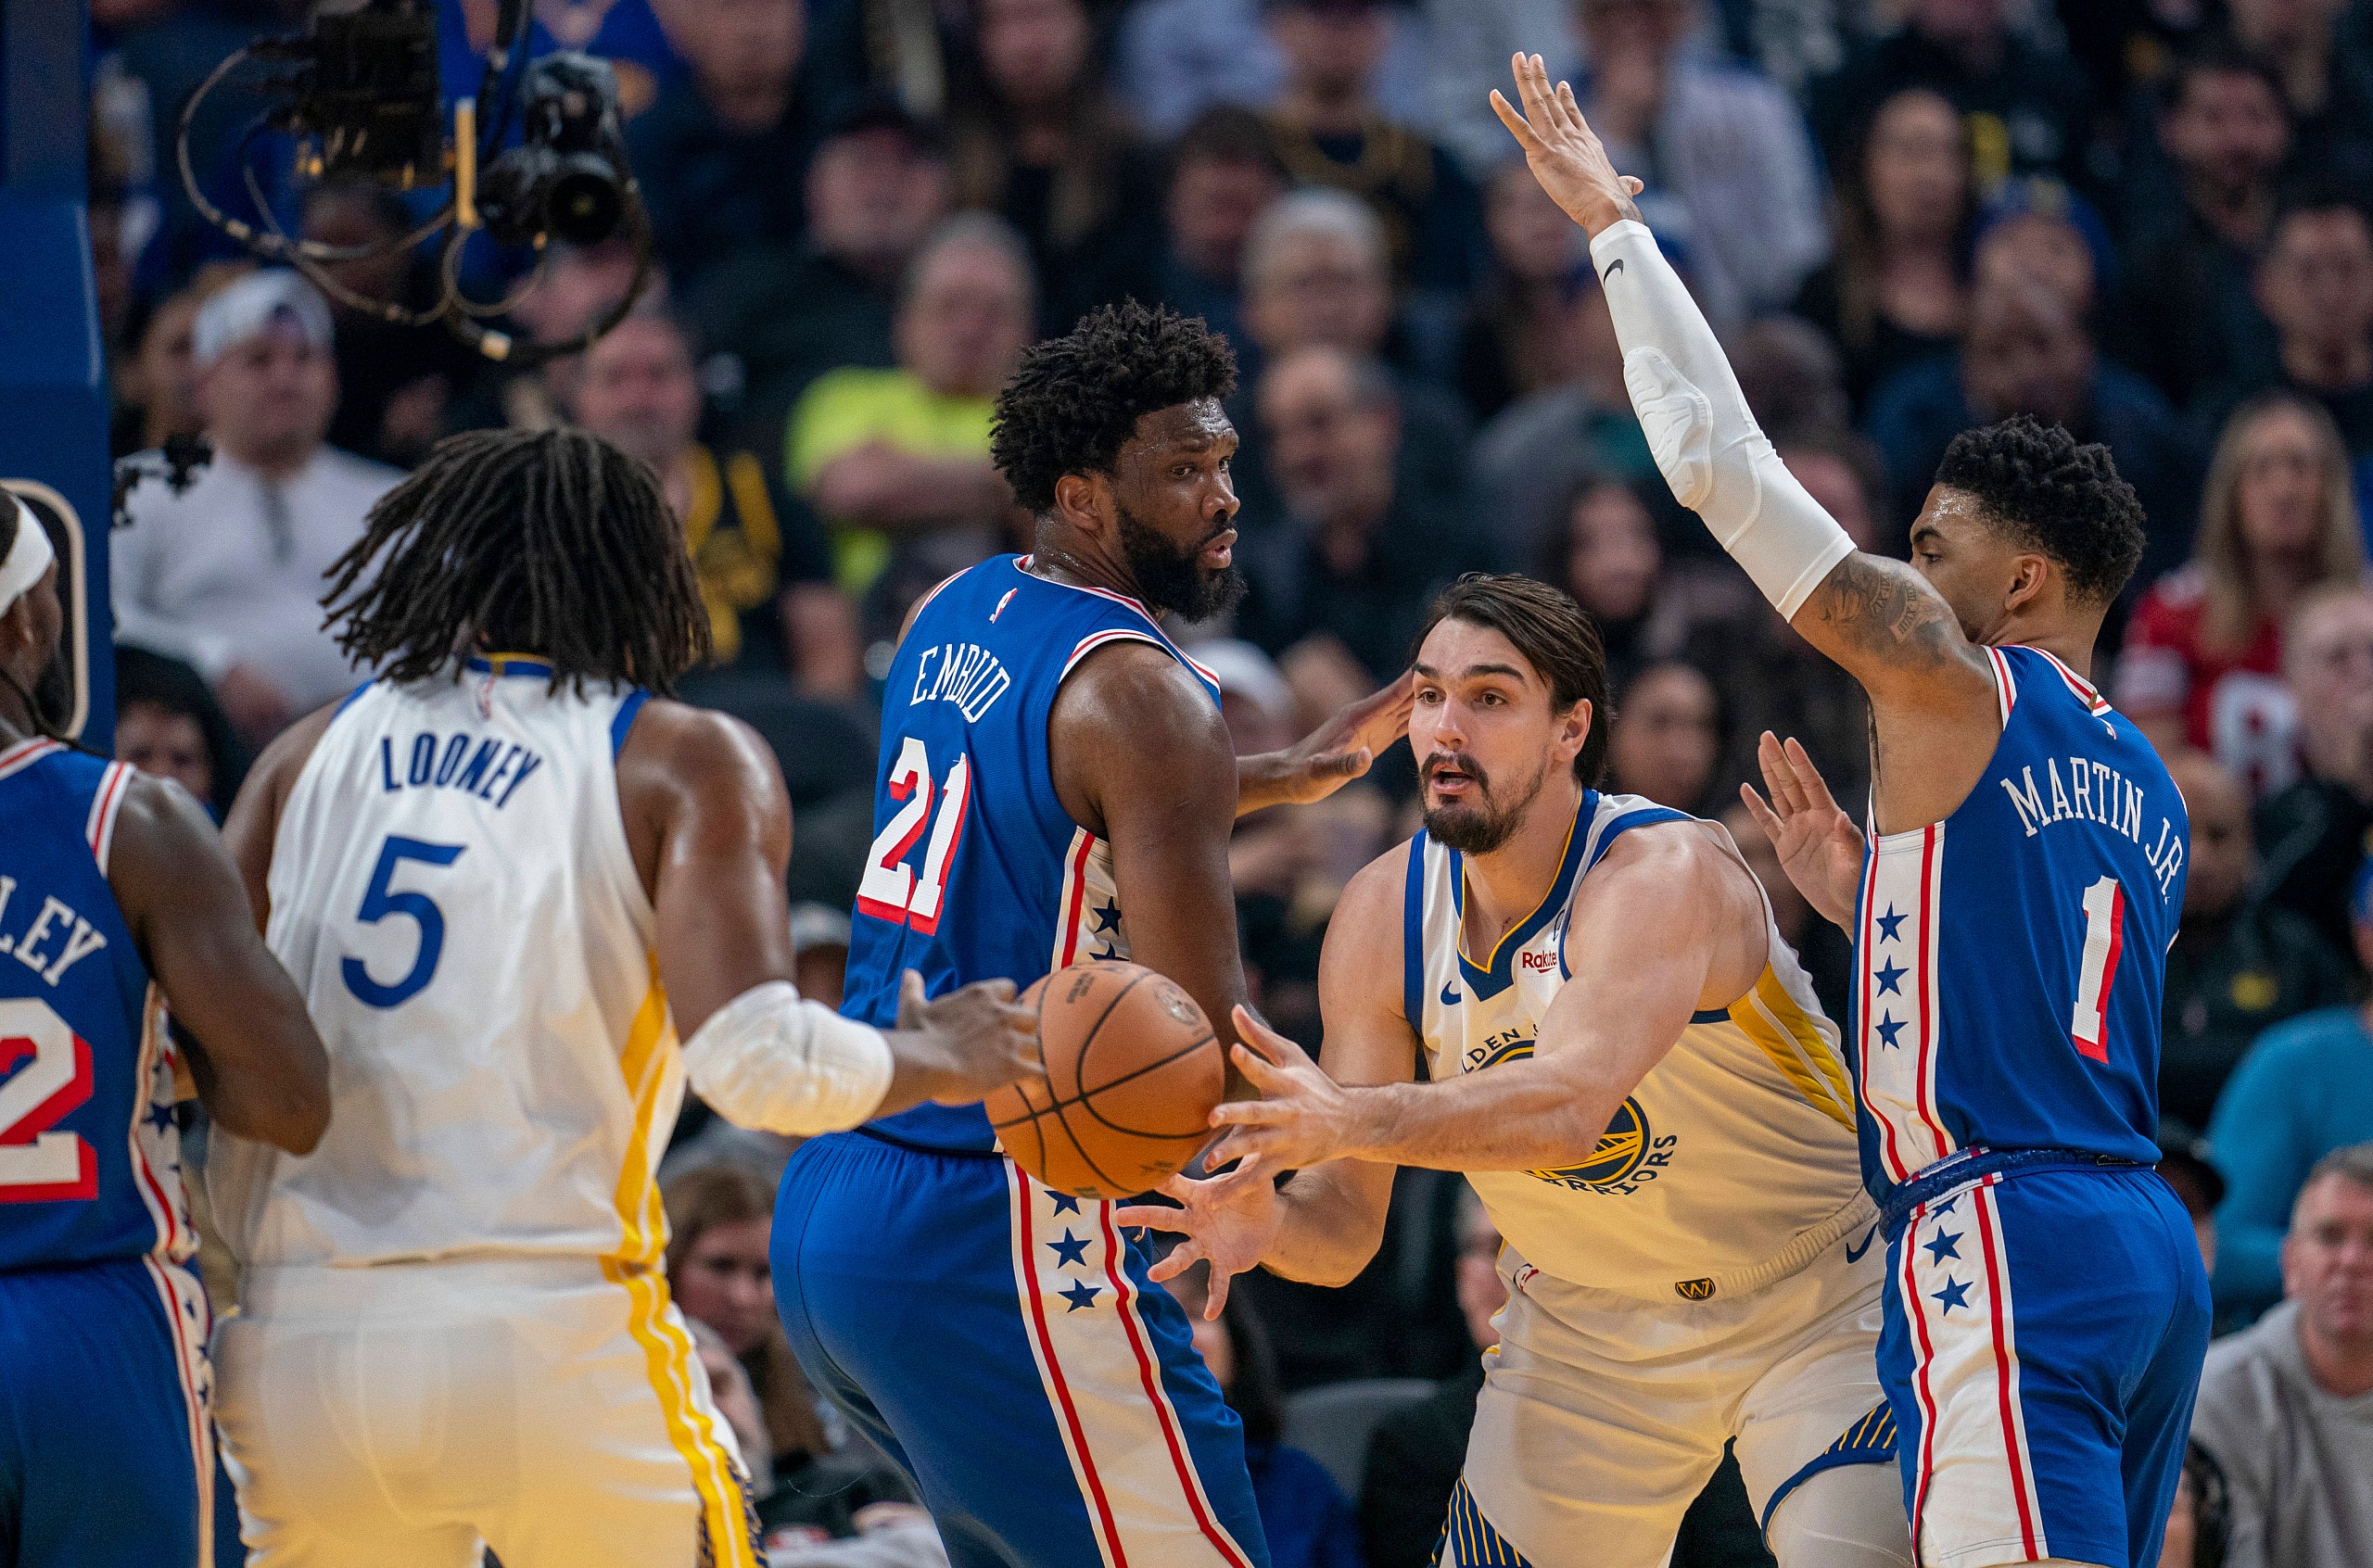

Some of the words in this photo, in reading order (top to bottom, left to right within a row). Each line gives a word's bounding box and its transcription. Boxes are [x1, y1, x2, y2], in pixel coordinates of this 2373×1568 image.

[909, 642, 1010, 723] EMBIID
[380, 732, 542, 810] LOONEY
[1999, 757, 2144, 844] MARTIN
[857, 737, 971, 936] 21
[340, 835, 466, 1009] 5
[1522, 950, 1557, 968] Rakute
[2072, 875, 2126, 1065] 1
[1461, 1028, 1521, 1074] LDEN
[1542, 1134, 1677, 1195] ARRIORS
